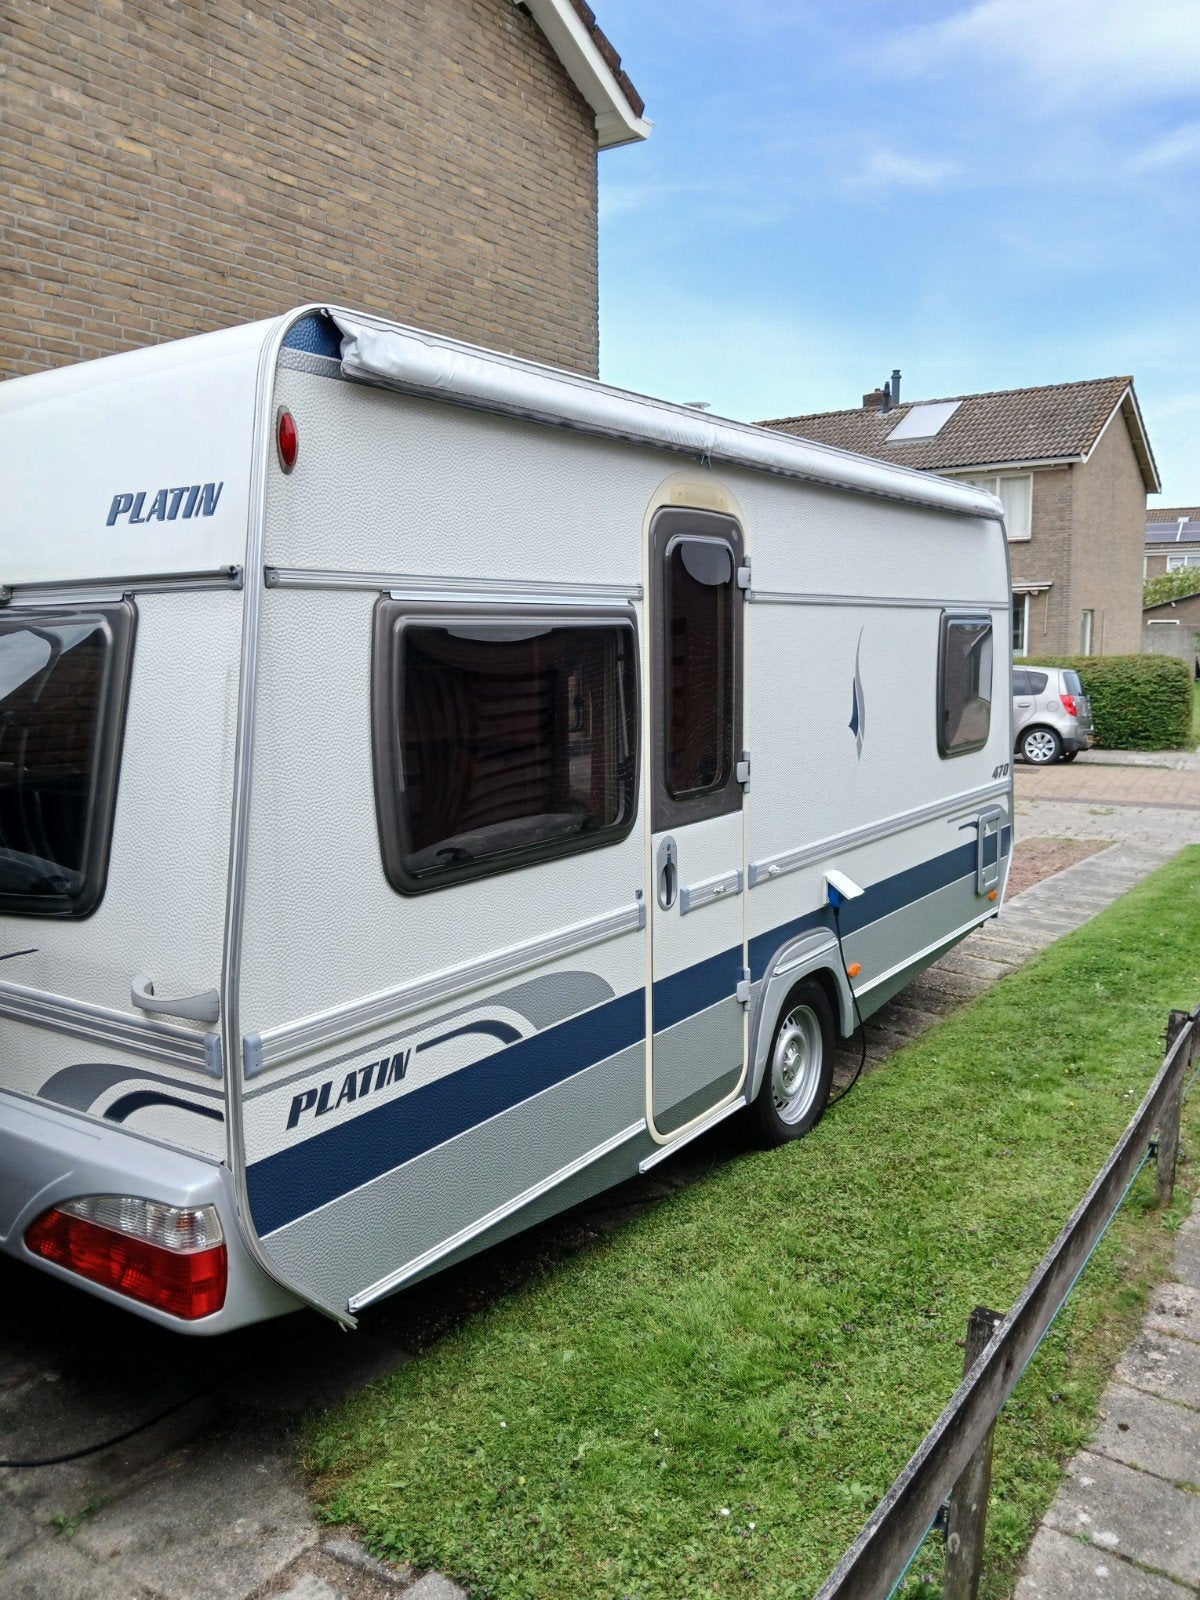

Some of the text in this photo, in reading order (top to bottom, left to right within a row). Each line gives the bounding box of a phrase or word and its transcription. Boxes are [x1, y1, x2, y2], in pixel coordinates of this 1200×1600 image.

[107, 482, 224, 526] PLATIN
[992, 763, 1009, 780] 470
[287, 1048, 411, 1130] PLATIN
